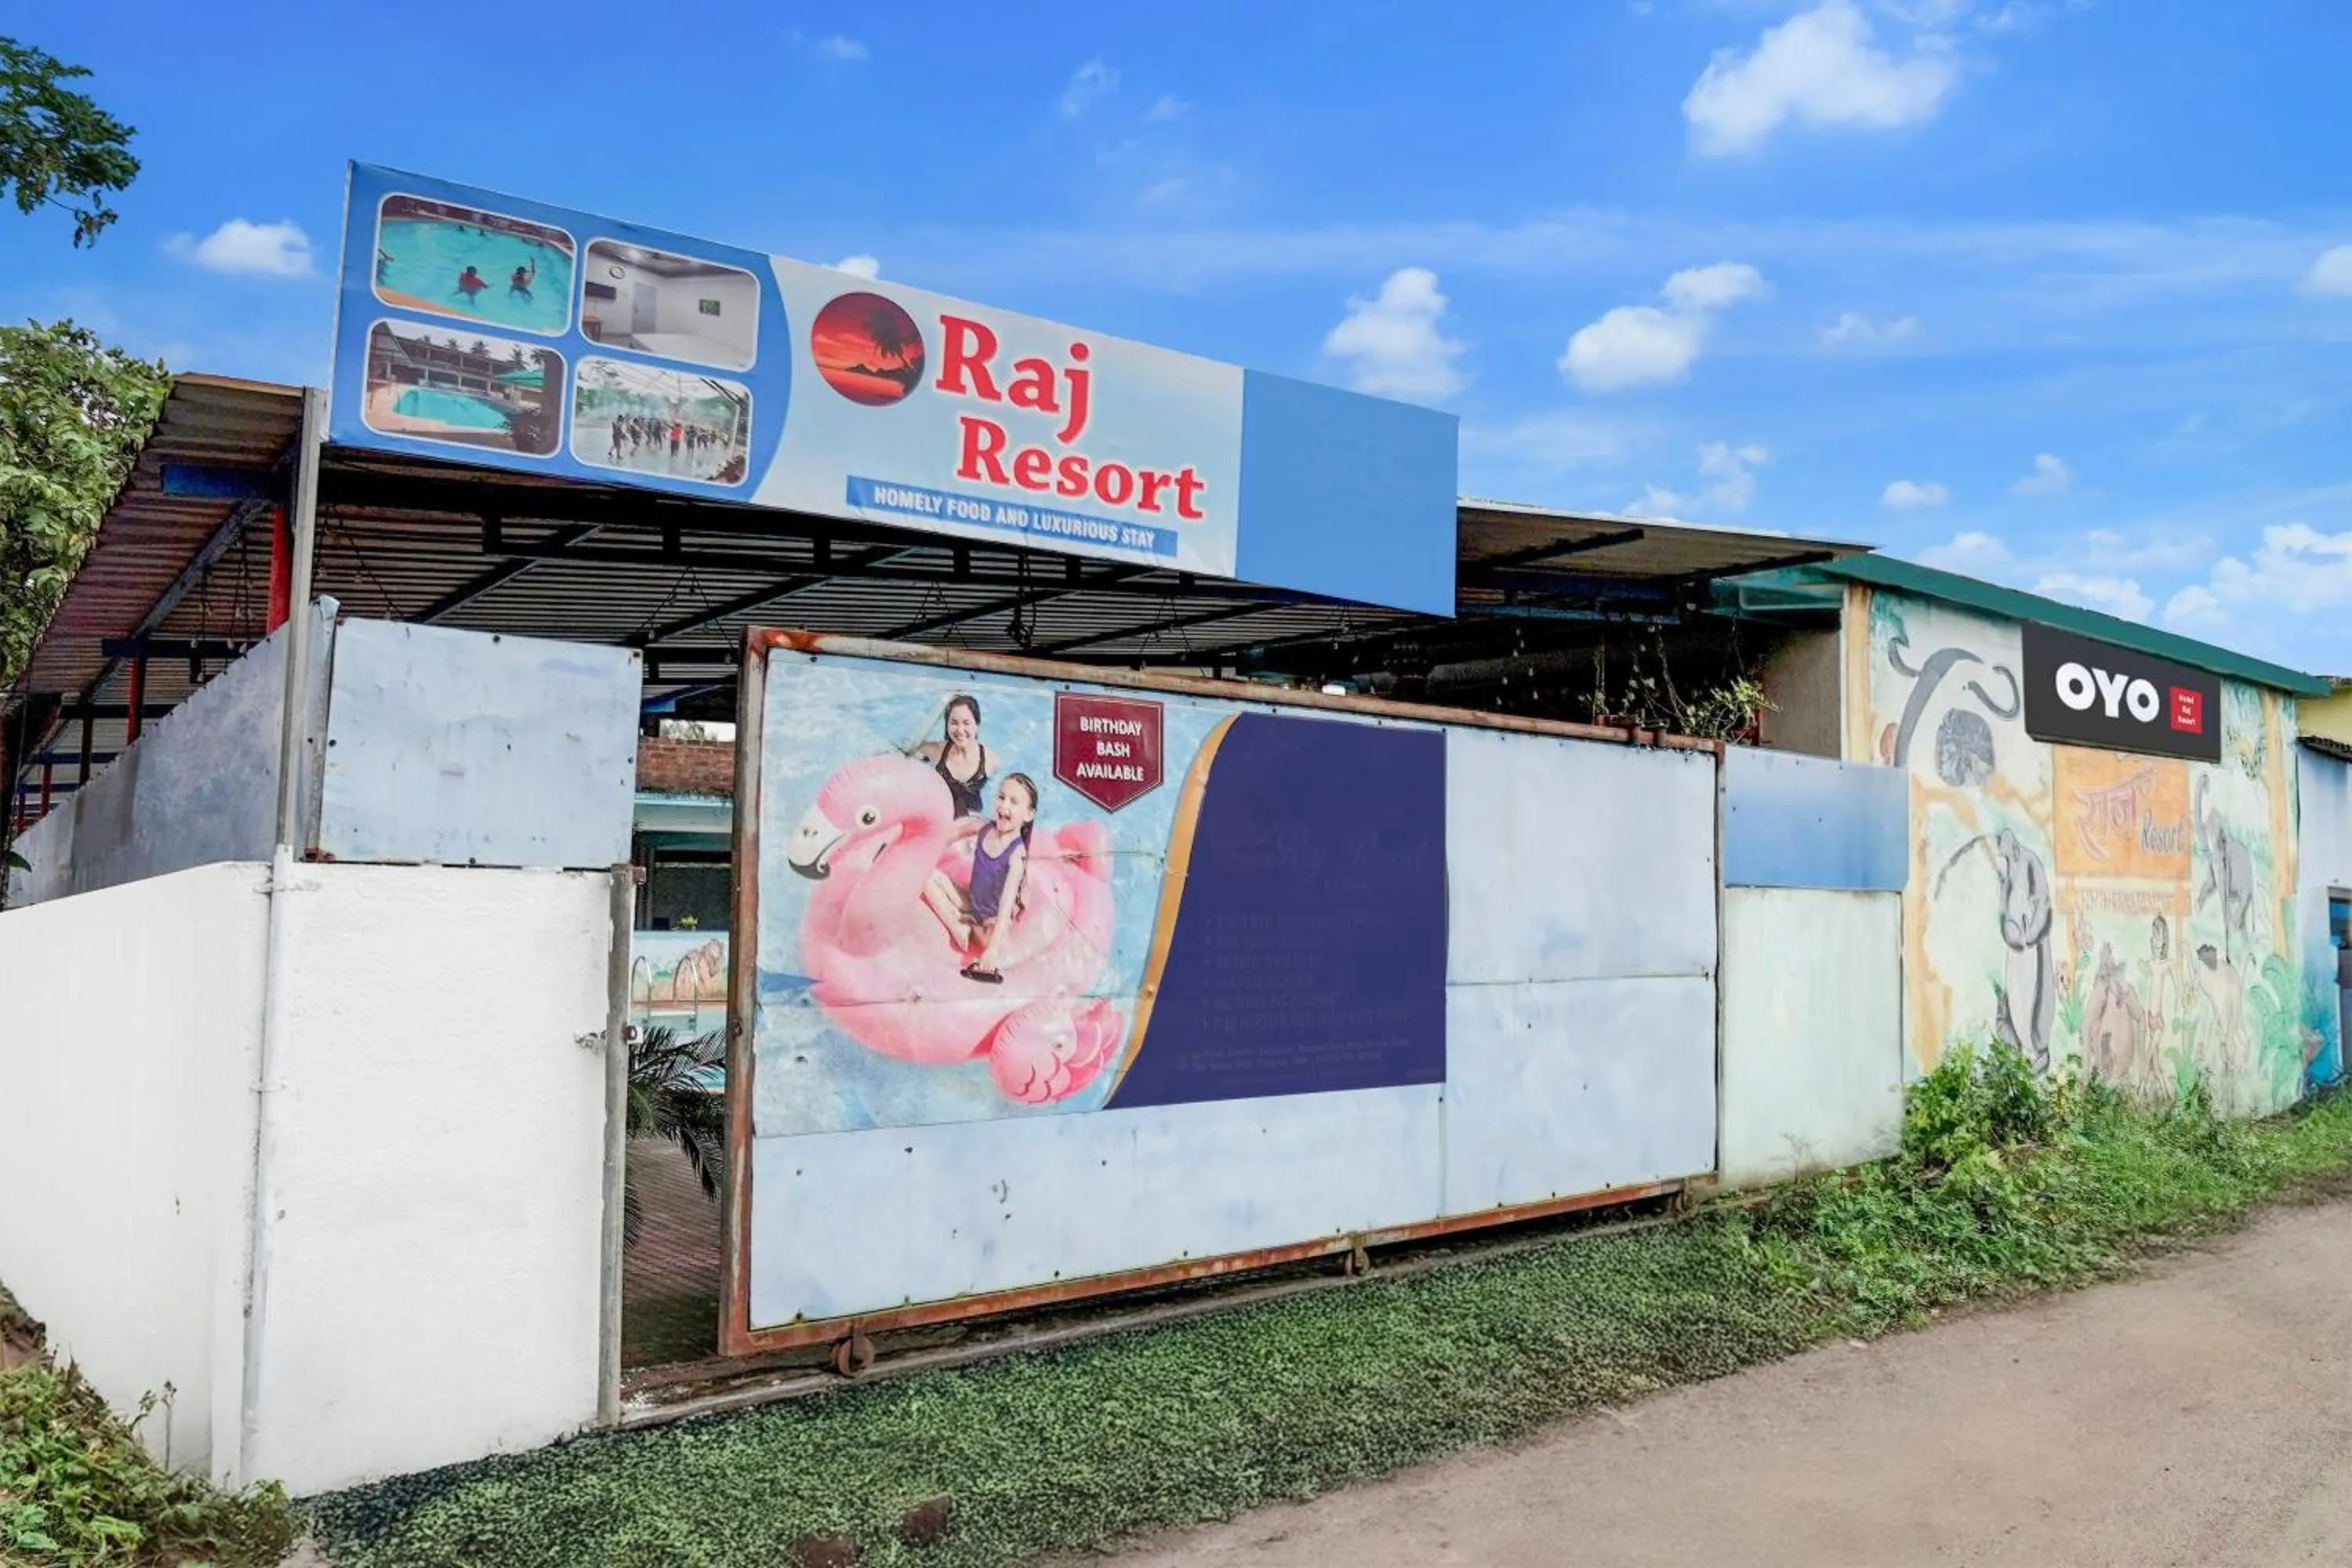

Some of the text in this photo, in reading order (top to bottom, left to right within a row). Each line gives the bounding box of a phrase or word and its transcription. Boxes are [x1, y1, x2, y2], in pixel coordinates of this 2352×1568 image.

[936, 314, 1090, 444] Raj
[957, 416, 1204, 519] Resort
[874, 486, 1156, 549] HOMELY FOOD AND LUXURIOUS STAY
[2055, 662, 2160, 723] OYO
[1079, 716, 1142, 735] BIRTHDAY
[1096, 740, 1131, 757] BASH
[1076, 762, 1145, 782] AVAILABLE
